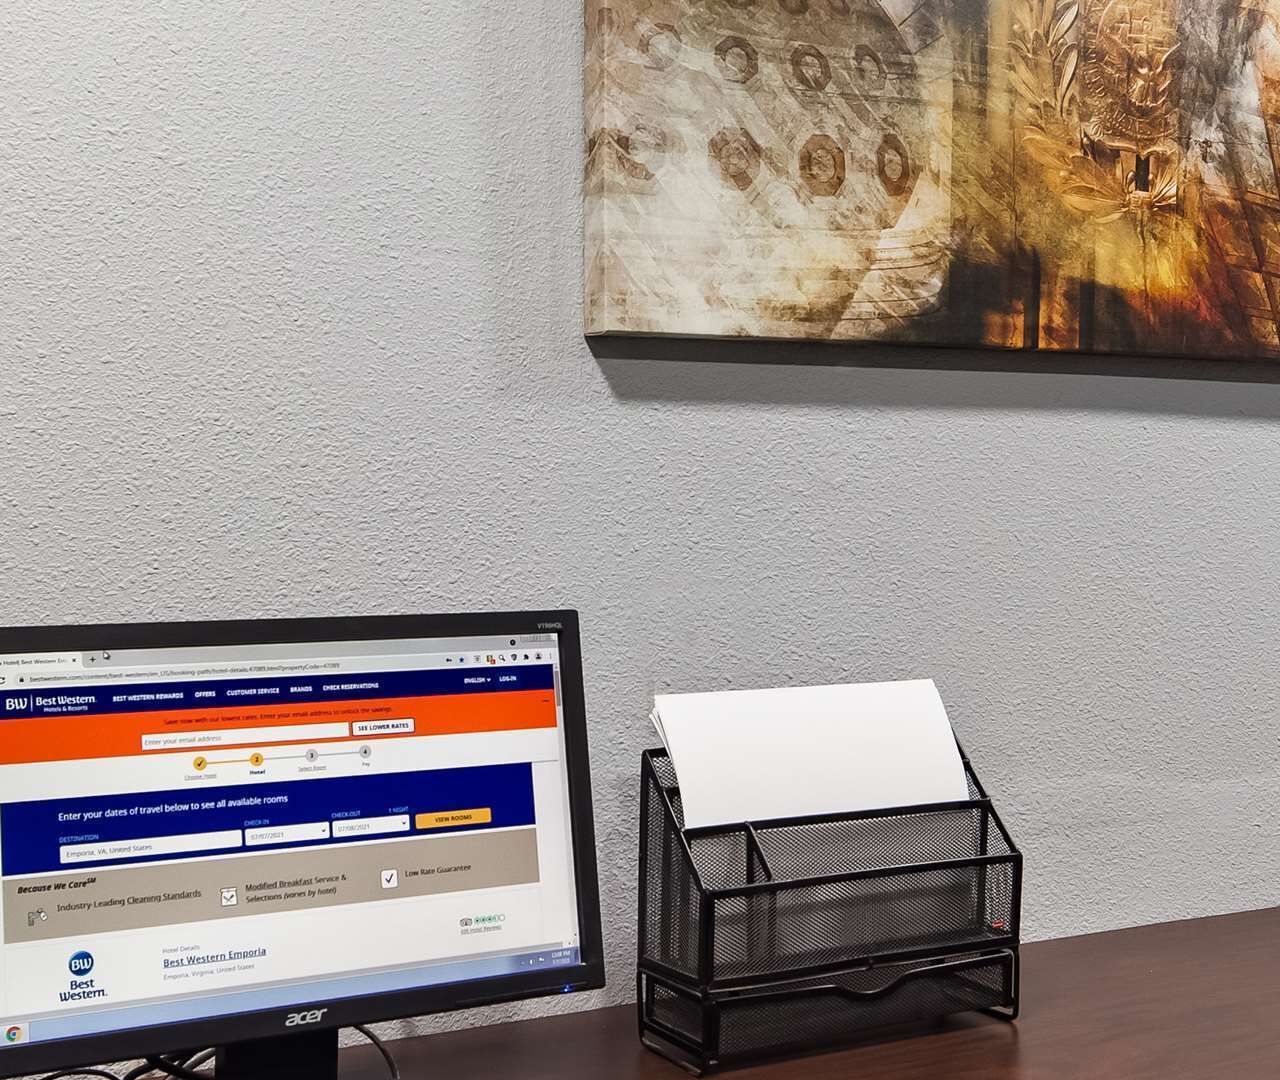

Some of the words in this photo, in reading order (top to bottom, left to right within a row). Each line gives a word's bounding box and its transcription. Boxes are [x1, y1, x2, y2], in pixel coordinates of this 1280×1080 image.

[226, 688, 257, 696] CUSTOMER
[340, 682, 379, 691] RESERVATIONS
[128, 693, 155, 701] WESTERN
[155, 692, 184, 700] REWARDS
[194, 690, 216, 698] OFFERS
[5, 697, 28, 710] BW
[36, 696, 56, 706] Best
[57, 695, 96, 705] Western
[310, 710, 333, 718] address
[369, 723, 390, 731] LOWER
[144, 738, 161, 746] Enter
[162, 737, 177, 747] your
[178, 736, 196, 744] email
[198, 735, 222, 743] address
[58, 812, 81, 822] Enter
[83, 810, 103, 822] your
[104, 808, 128, 818] dates
[129, 806, 139, 816] of
[139, 804, 163, 815] travel
[164, 802, 190, 813] below
[190, 802, 200, 811] to
[200, 802, 216, 810] see
[216, 799, 227, 809] all
[227, 796, 262, 807] available
[263, 794, 289, 805] rooms
[451, 813, 473, 821] ROOMS
[58, 833, 100, 843] DESTINATION
[405, 870, 419, 878] Low
[420, 867, 436, 875] Rate
[436, 864, 472, 874] Guarantee
[17, 884, 51, 894] Because
[53, 882, 67, 891] We
[245, 882, 278, 892] Modified
[278, 877, 313, 888] Breakfast
[314, 876, 340, 884] Service
[340, 873, 347, 881] &
[126, 894, 162, 905] Cleaning
[162, 889, 202, 901] Standards
[246, 893, 283, 903] Selections
[307, 889, 316, 899] by
[71, 957, 92, 971] BW
[163, 958, 186, 969] Best
[186, 953, 226, 965] Western
[227, 947, 267, 961] Emporia
[70, 979, 95, 991] Best
[59, 988, 105, 1002] Western
[285, 1008, 328, 1027] acer
